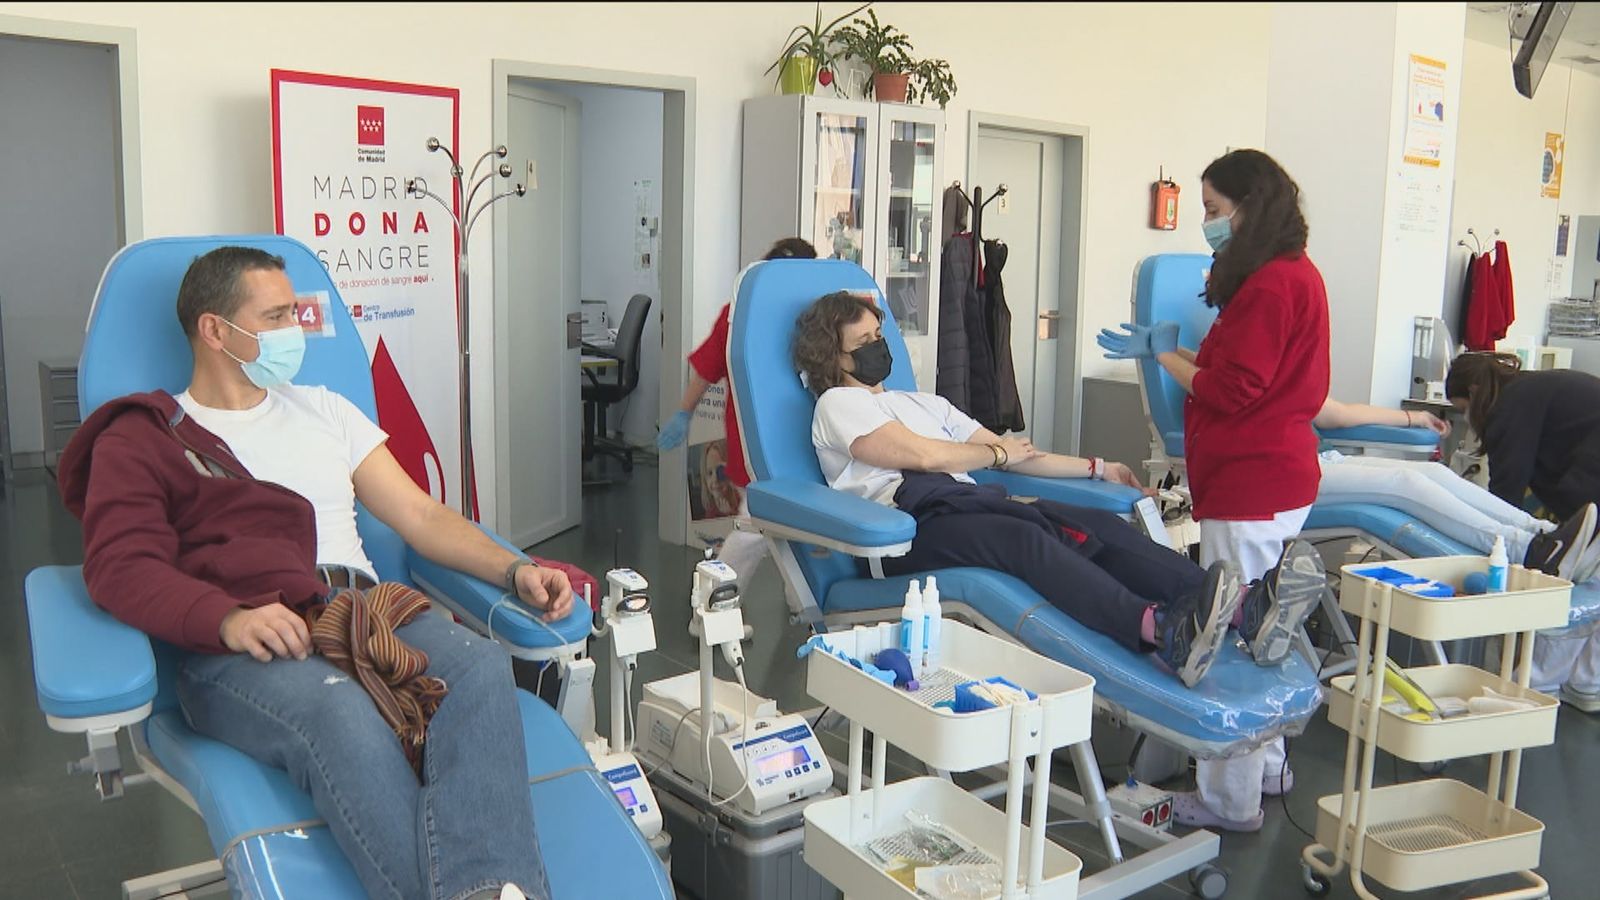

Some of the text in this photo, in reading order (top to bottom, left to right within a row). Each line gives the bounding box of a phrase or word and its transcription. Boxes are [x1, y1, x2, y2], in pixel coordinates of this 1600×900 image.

[314, 175, 427, 199] MADRID
[314, 211, 429, 236] DONA
[317, 245, 429, 272] SANGRE
[339, 280, 348, 289] de
[350, 278, 380, 288] donación
[382, 276, 390, 286] de
[391, 276, 412, 286] sangre
[301, 306, 316, 324] 4
[363, 307, 415, 322] de Transfusión
